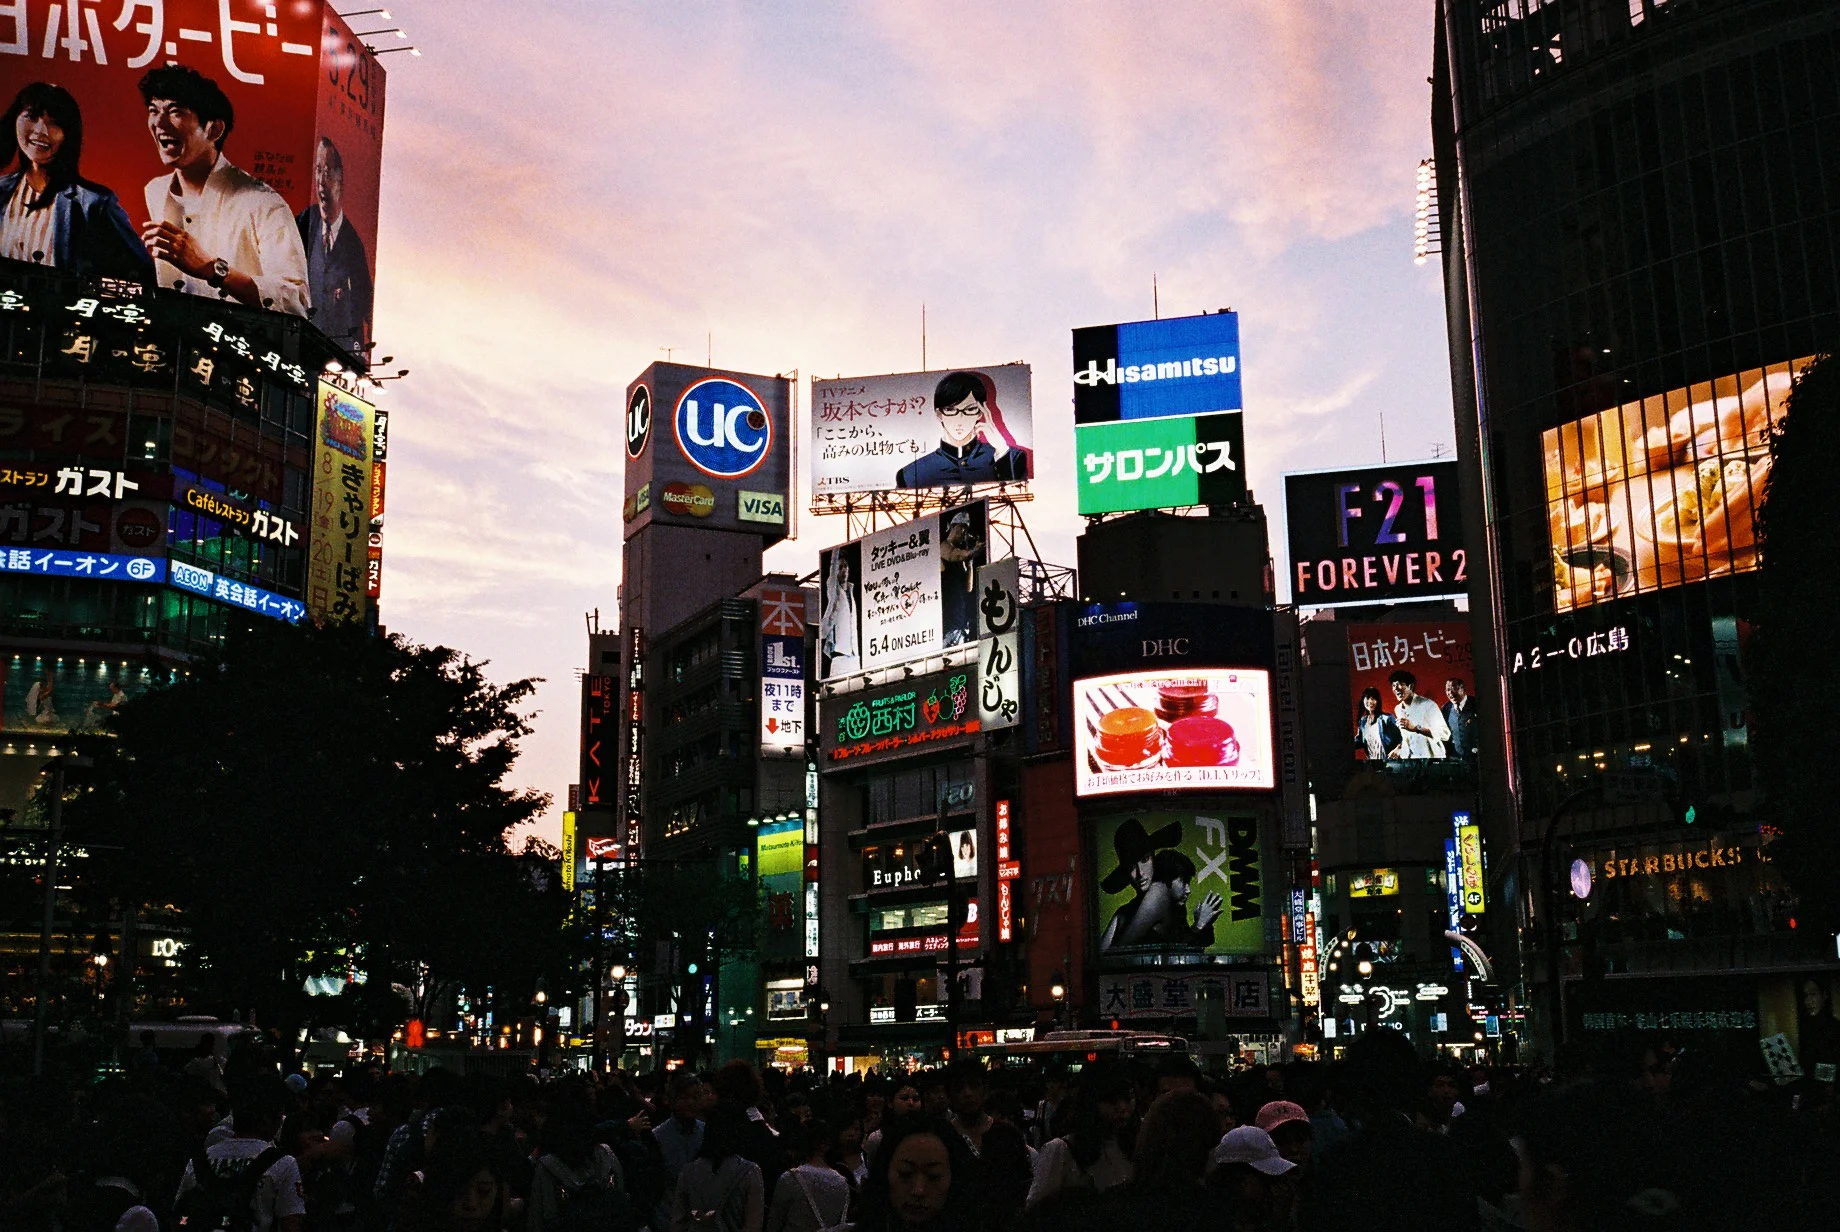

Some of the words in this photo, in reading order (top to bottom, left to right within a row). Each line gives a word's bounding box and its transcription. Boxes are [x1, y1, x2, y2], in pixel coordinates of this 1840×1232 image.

[1074, 356, 1236, 387] Hisamitsu
[687, 400, 764, 453] UC
[1084, 441, 1236, 484] サロンパス
[54, 466, 139, 500] ガスト
[826, 477, 850, 485] TBS
[663, 491, 715, 506] MasterCard
[744, 498, 783, 516] VISA
[1335, 475, 1438, 548] F21
[252, 510, 299, 548] ガスト
[131, 562, 152, 577] 6F
[175, 565, 208, 591] AEON
[1297, 551, 1443, 593] FOREVER
[215, 576, 306, 620] 英会話イーオン
[1078, 615, 1098, 627] DHC
[1099, 610, 1138, 623] Channel
[869, 634, 889, 657] 5.4
[891, 636, 904, 650] ON
[981, 578, 1018, 722] もんじゃ
[1142, 638, 1189, 657] DHC
[1352, 629, 1456, 671] 日本ダービー
[602, 676, 612, 716] TOKYO
[764, 683, 802, 697] 夜11時
[772, 699, 795, 713] まで
[872, 702, 916, 736] 西村
[780, 719, 802, 734] 地下
[1195, 815, 1229, 885] FX
[1604, 847, 1742, 879] STARBUCKS
[1468, 894, 1480, 905] 4F
[1106, 979, 1260, 1010] 大盛堂店
